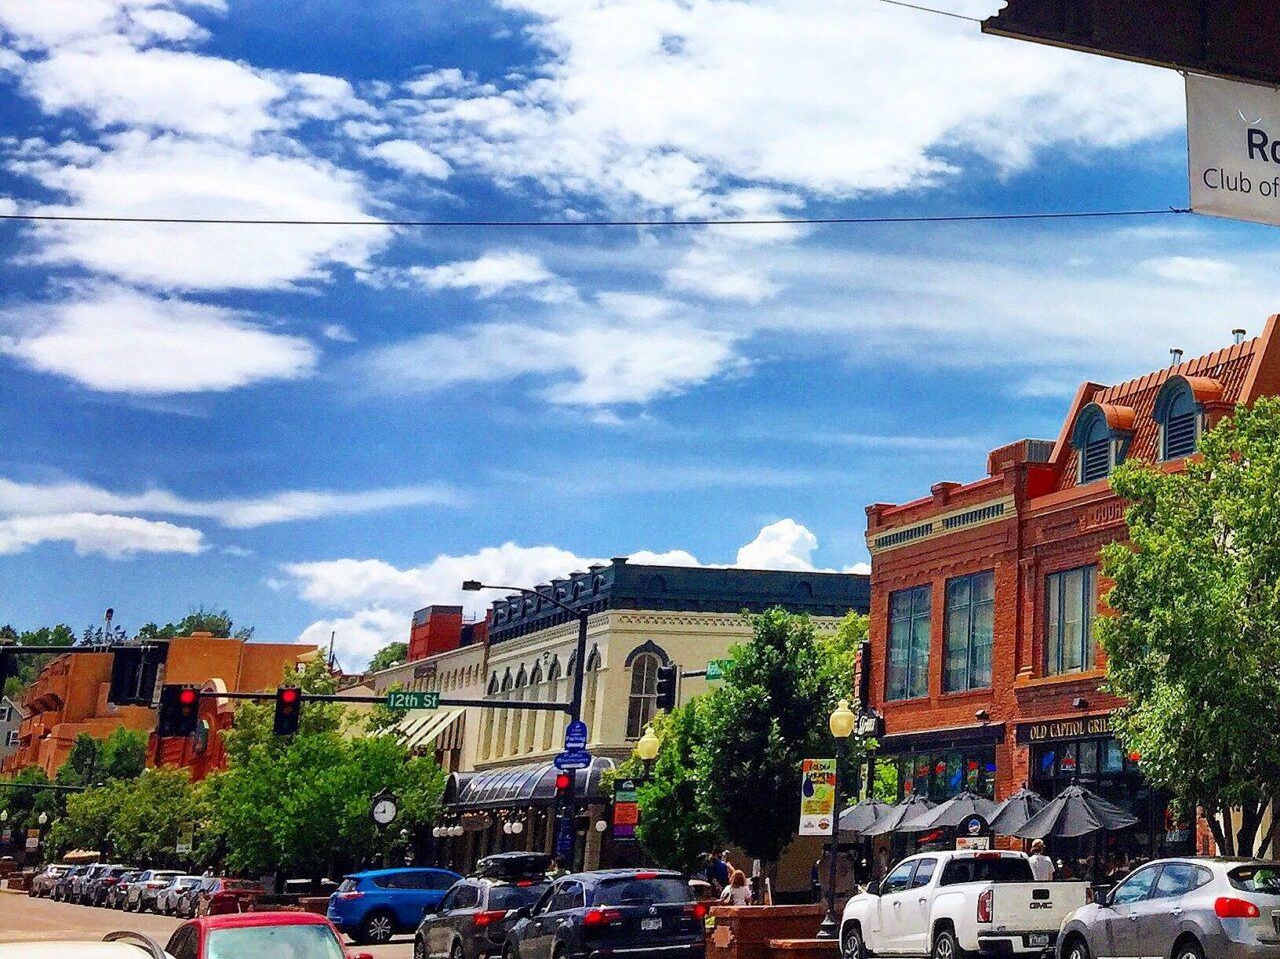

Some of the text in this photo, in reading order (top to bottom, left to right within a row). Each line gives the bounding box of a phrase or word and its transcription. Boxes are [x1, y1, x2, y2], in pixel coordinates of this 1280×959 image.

[1202, 167, 1254, 193] Club
[1258, 174, 1280, 198] of
[390, 694, 437, 707] 12th St
[1030, 724, 1046, 740] OLD
[1050, 721, 1085, 738] CAPITOL
